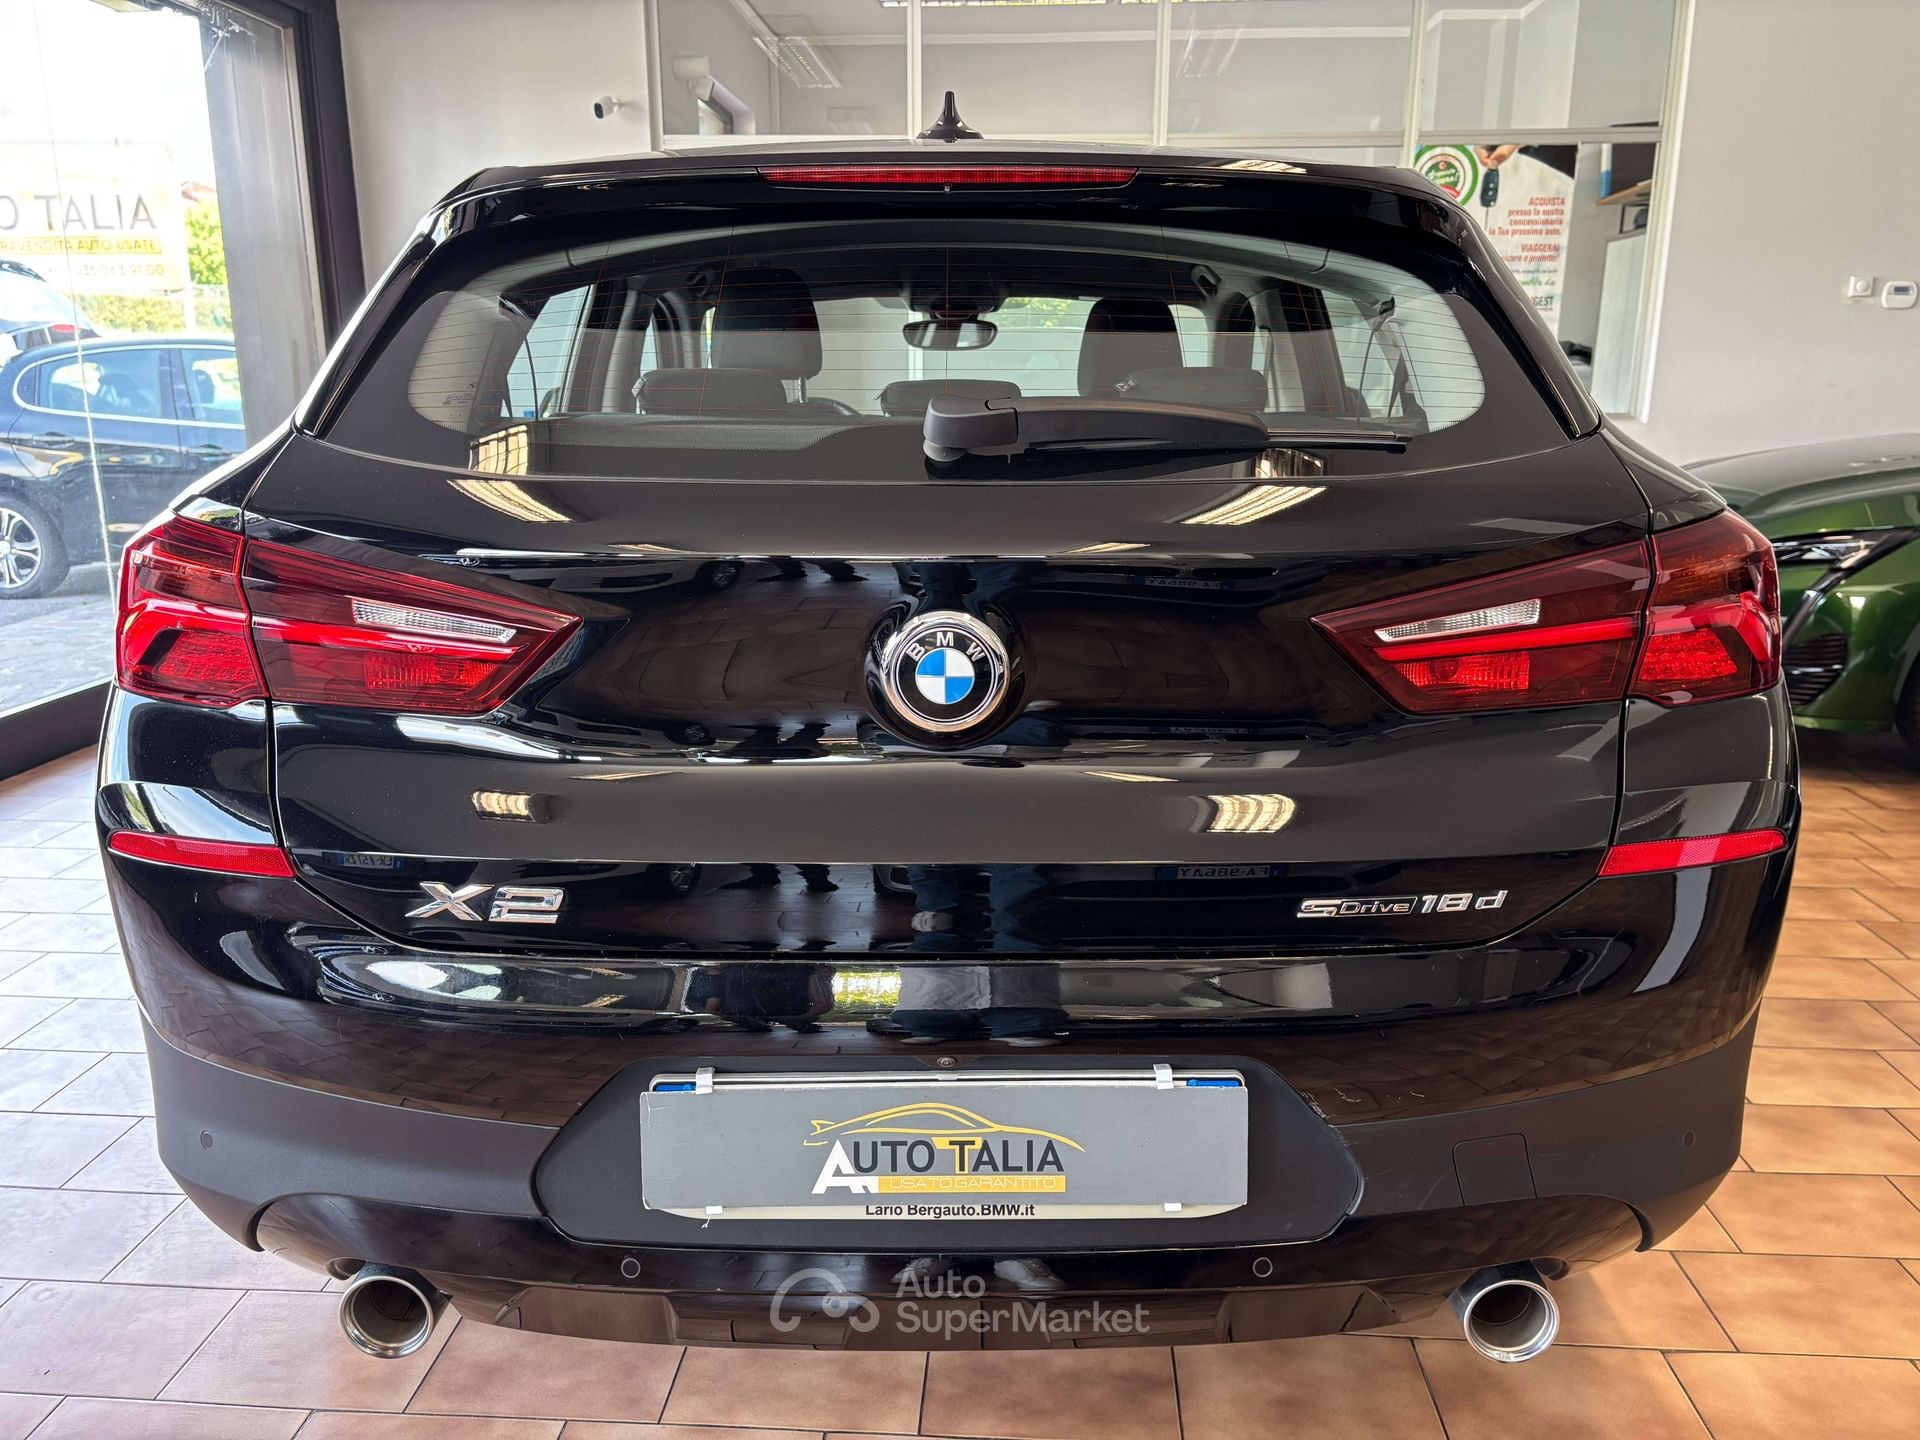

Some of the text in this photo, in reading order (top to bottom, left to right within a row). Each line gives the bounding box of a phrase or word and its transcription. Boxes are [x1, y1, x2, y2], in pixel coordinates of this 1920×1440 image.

[33, 193, 158, 231] TALIA
[1528, 197, 1565, 206] ACQUISTA
[77, 239, 112, 251] AUTO
[905, 632, 986, 662] BMW
[404, 880, 566, 924] X2
[811, 1138, 1065, 1194] AUTO TALIA
